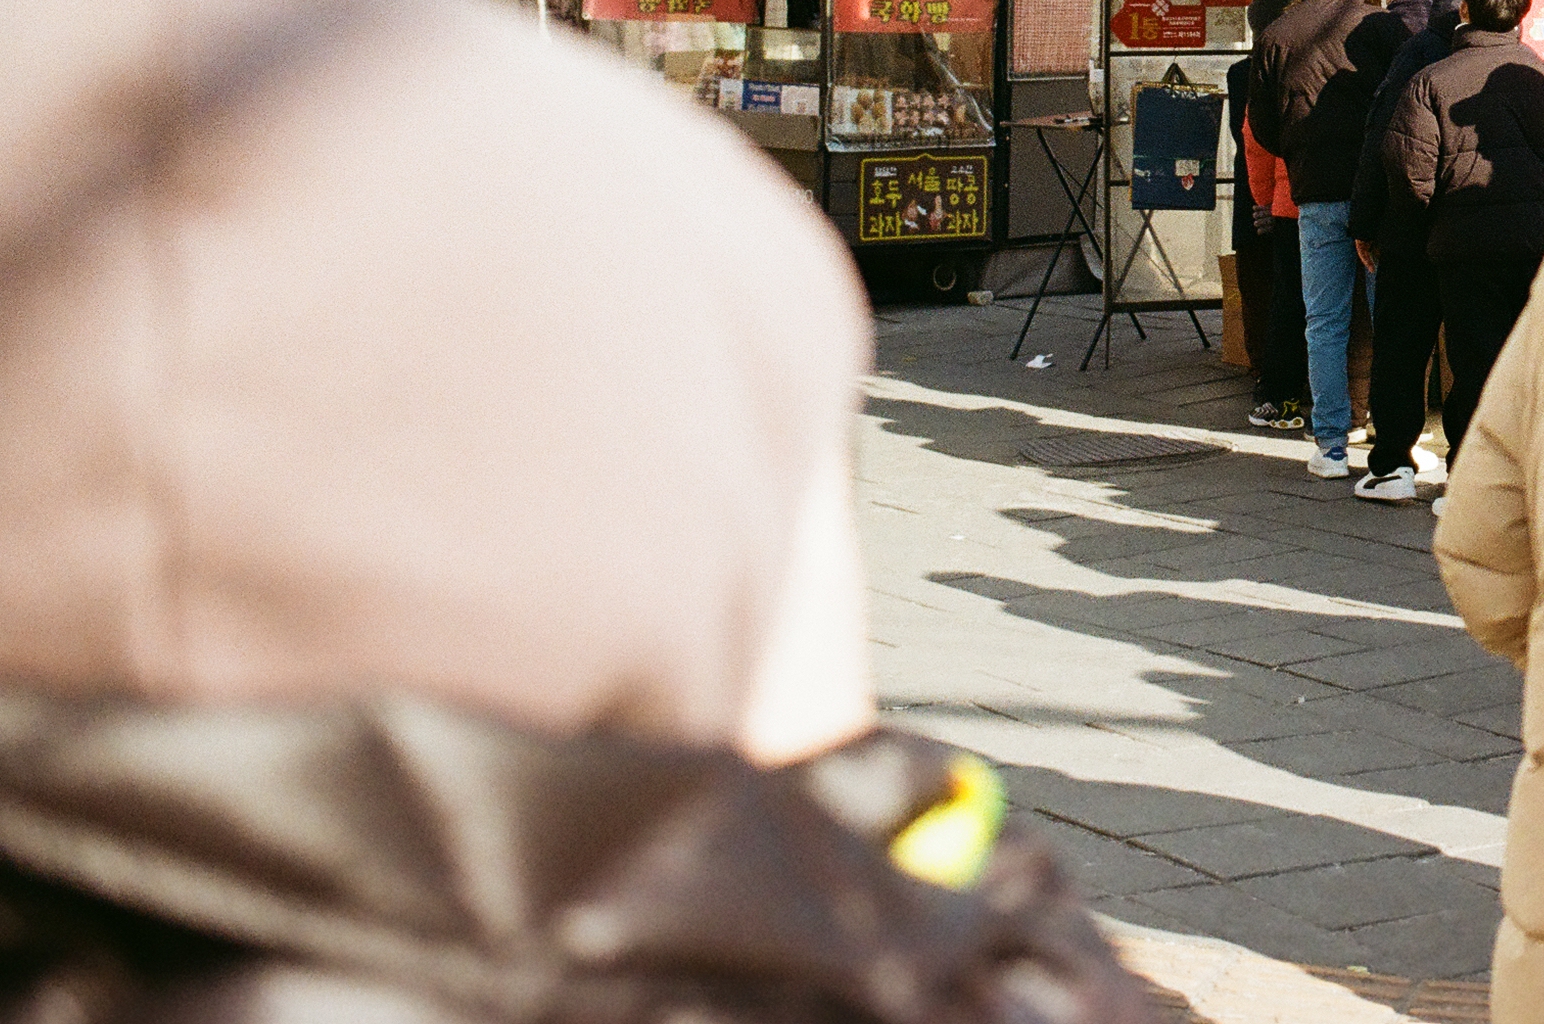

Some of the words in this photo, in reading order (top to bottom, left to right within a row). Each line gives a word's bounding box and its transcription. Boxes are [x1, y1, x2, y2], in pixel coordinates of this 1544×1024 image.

[871, 0, 951, 24] 국화빵
[1128, 13, 1159, 39] 1등
[908, 166, 941, 192] 서울
[947, 175, 979, 205] 땅콩
[869, 179, 902, 208] 호두
[870, 211, 903, 236] 과자
[947, 209, 979, 236] 과자
